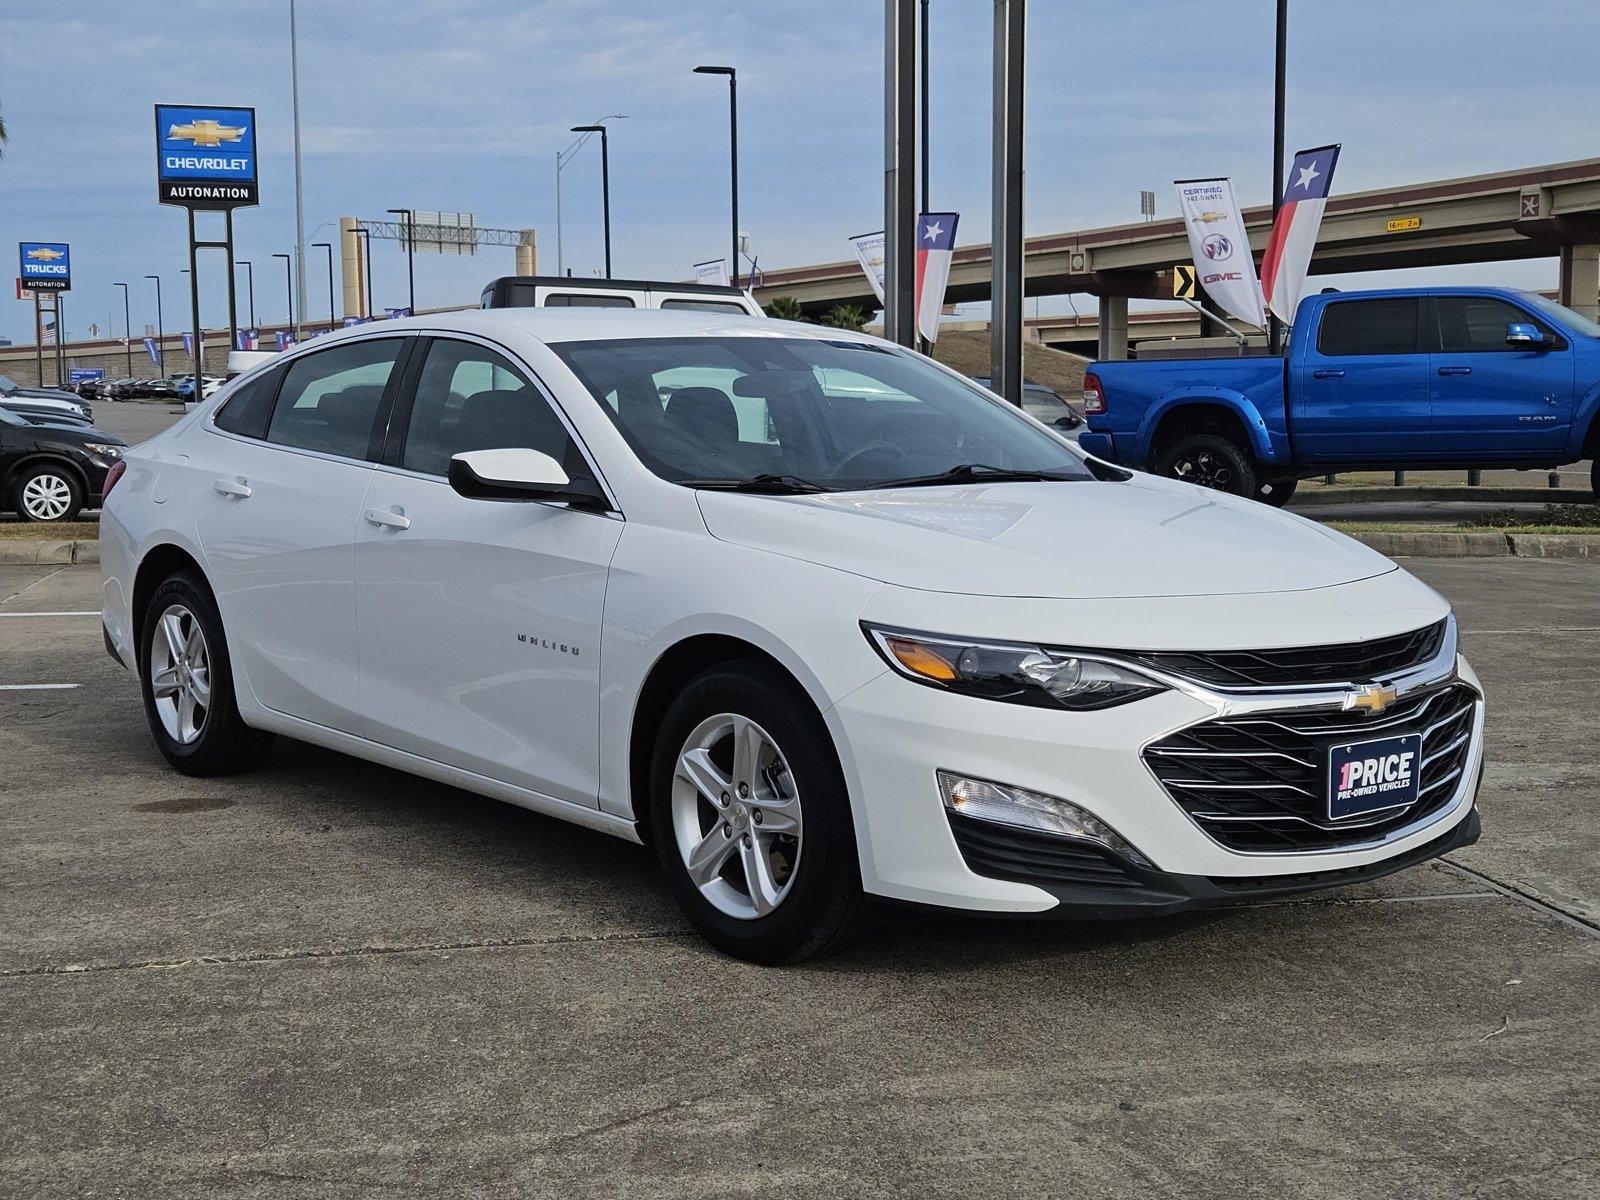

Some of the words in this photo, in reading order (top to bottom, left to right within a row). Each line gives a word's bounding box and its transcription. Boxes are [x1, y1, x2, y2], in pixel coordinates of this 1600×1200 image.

[166, 157, 248, 170] CHEVROLET
[170, 187, 249, 198] AUTONATION
[1183, 186, 1223, 196] CERTIFIED
[25, 264, 67, 274] TRUCKS
[1203, 272, 1243, 284] GMC
[517, 633, 580, 656] MALIBU
[1337, 785, 1378, 800] PRE-OWNED
[1379, 779, 1411, 792] VEHICLES
